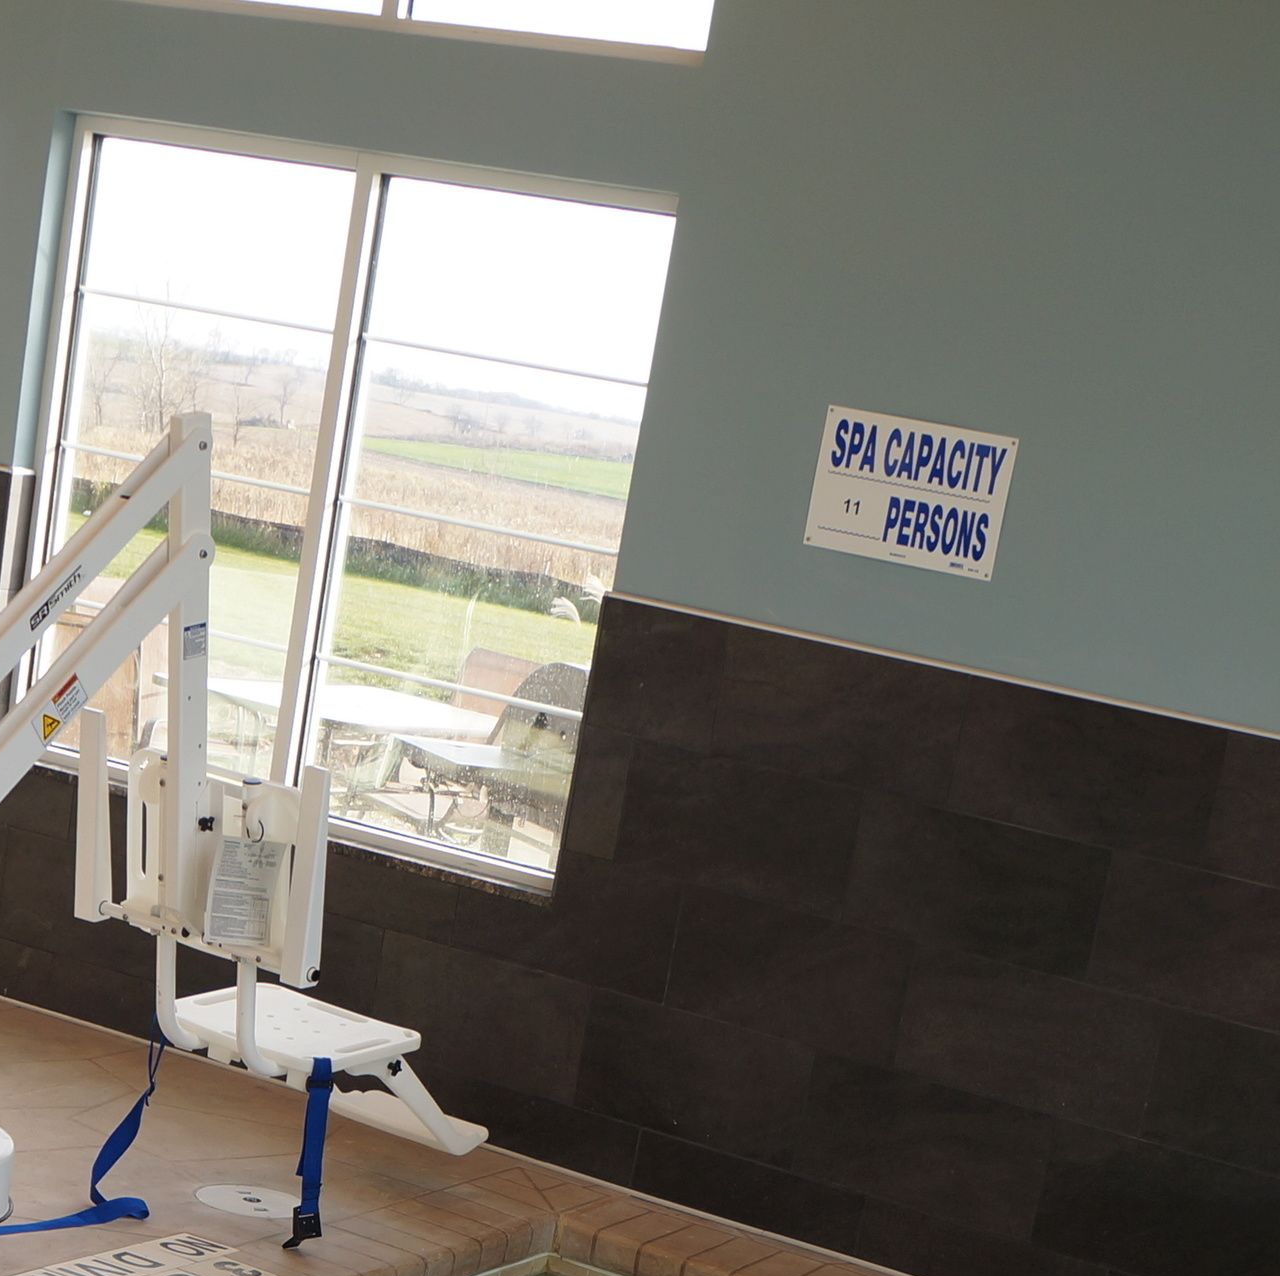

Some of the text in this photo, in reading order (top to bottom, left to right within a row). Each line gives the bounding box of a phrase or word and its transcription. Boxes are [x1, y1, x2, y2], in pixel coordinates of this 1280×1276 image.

[831, 419, 1008, 495] SPA CAPACITY
[843, 496, 989, 561] 11 PERSONS
[159, 1236, 228, 1256] NO
